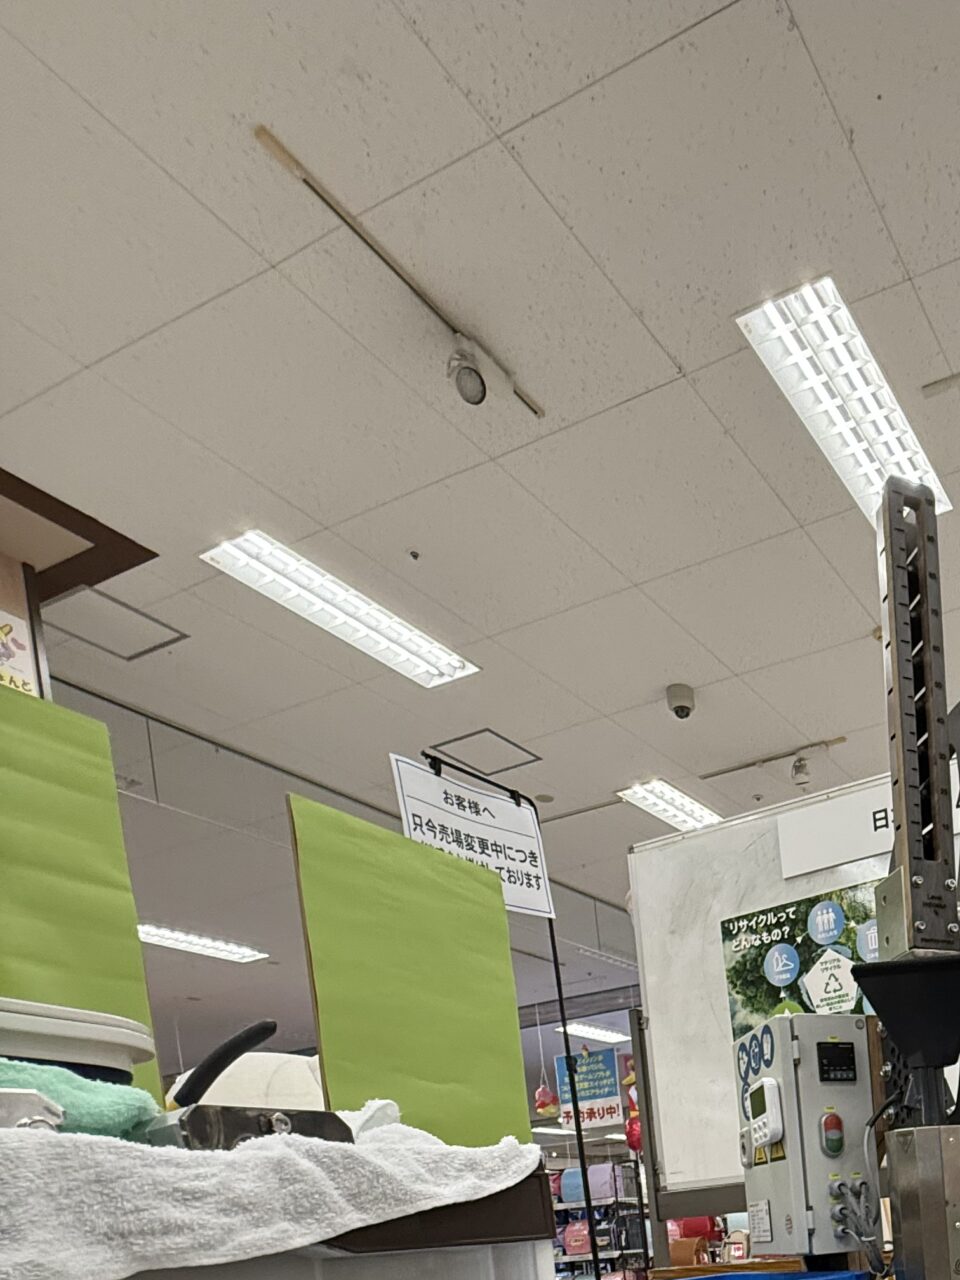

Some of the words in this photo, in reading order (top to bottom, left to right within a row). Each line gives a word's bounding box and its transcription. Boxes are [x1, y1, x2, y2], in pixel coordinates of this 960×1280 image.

[442, 789, 496, 819] お客様へ
[411, 813, 539, 868] 只今売場変更中につき
[729, 907, 797, 934] リサイクルって
[731, 927, 791, 952] どんなもの?
